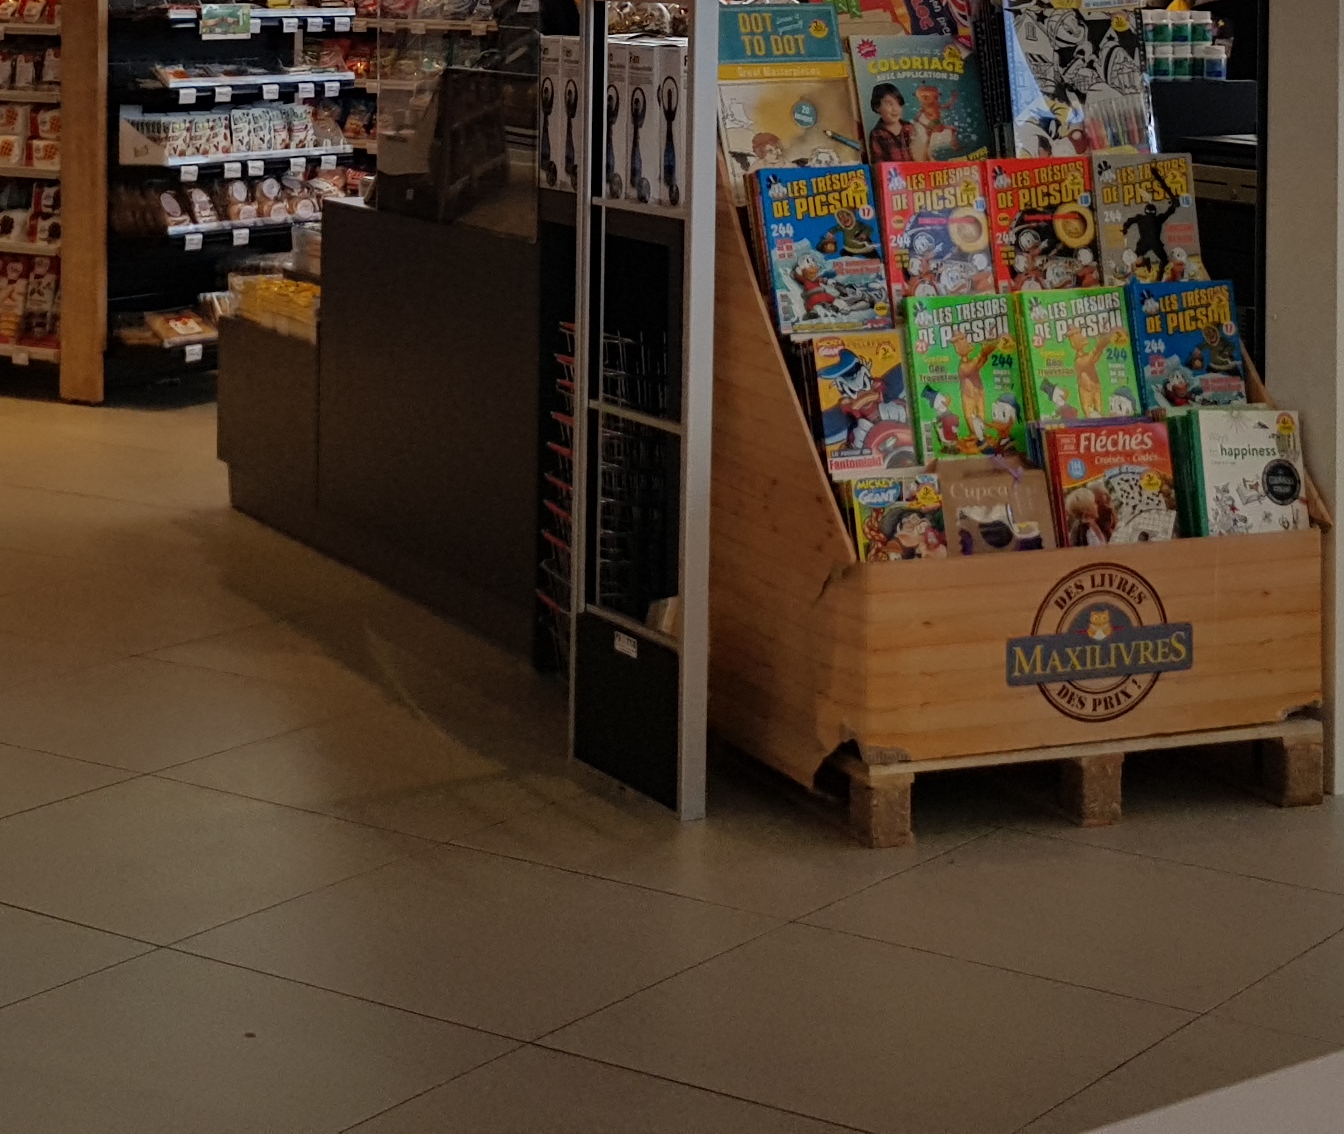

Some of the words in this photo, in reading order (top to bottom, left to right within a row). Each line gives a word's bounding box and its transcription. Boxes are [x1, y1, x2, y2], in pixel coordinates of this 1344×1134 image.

[738, 12, 772, 34] DOT
[740, 34, 766, 56] TO
[770, 34, 806, 56] DOT
[868, 56, 964, 75] COLORIAGE
[907, 172, 926, 190] LES
[1010, 170, 1030, 189] LES
[1116, 167, 1135, 184] LES
[787, 179, 807, 198] LES
[1102, 185, 1119, 204] DE
[772, 199, 790, 219] DE
[891, 194, 908, 211] DE
[997, 190, 1014, 209] DE
[770, 223, 794, 238] 244
[932, 307, 953, 325] LES
[956, 296, 1007, 320] TRÉSORS
[1047, 302, 1067, 320] LES
[1070, 292, 1120, 315] TRÉSORS
[1159, 294, 1179, 312] LES
[1034, 324, 1051, 340] DE
[1146, 315, 1163, 333] DE
[918, 328, 936, 346] DE
[1144, 339, 1165, 354] 244
[991, 355, 1013, 368] 244
[1107, 348, 1128, 362] 244
[1079, 428, 1153, 454] Fléchés
[1219, 443, 1277, 460] happiness
[856, 477, 895, 490] MICKEY
[1054, 578, 1085, 611] DES
[1090, 572, 1147, 606] LIVRES
[1011, 630, 1187, 678] MAXILIVRES
[1056, 684, 1087, 712] DES
[1091, 687, 1133, 713] PRIX
